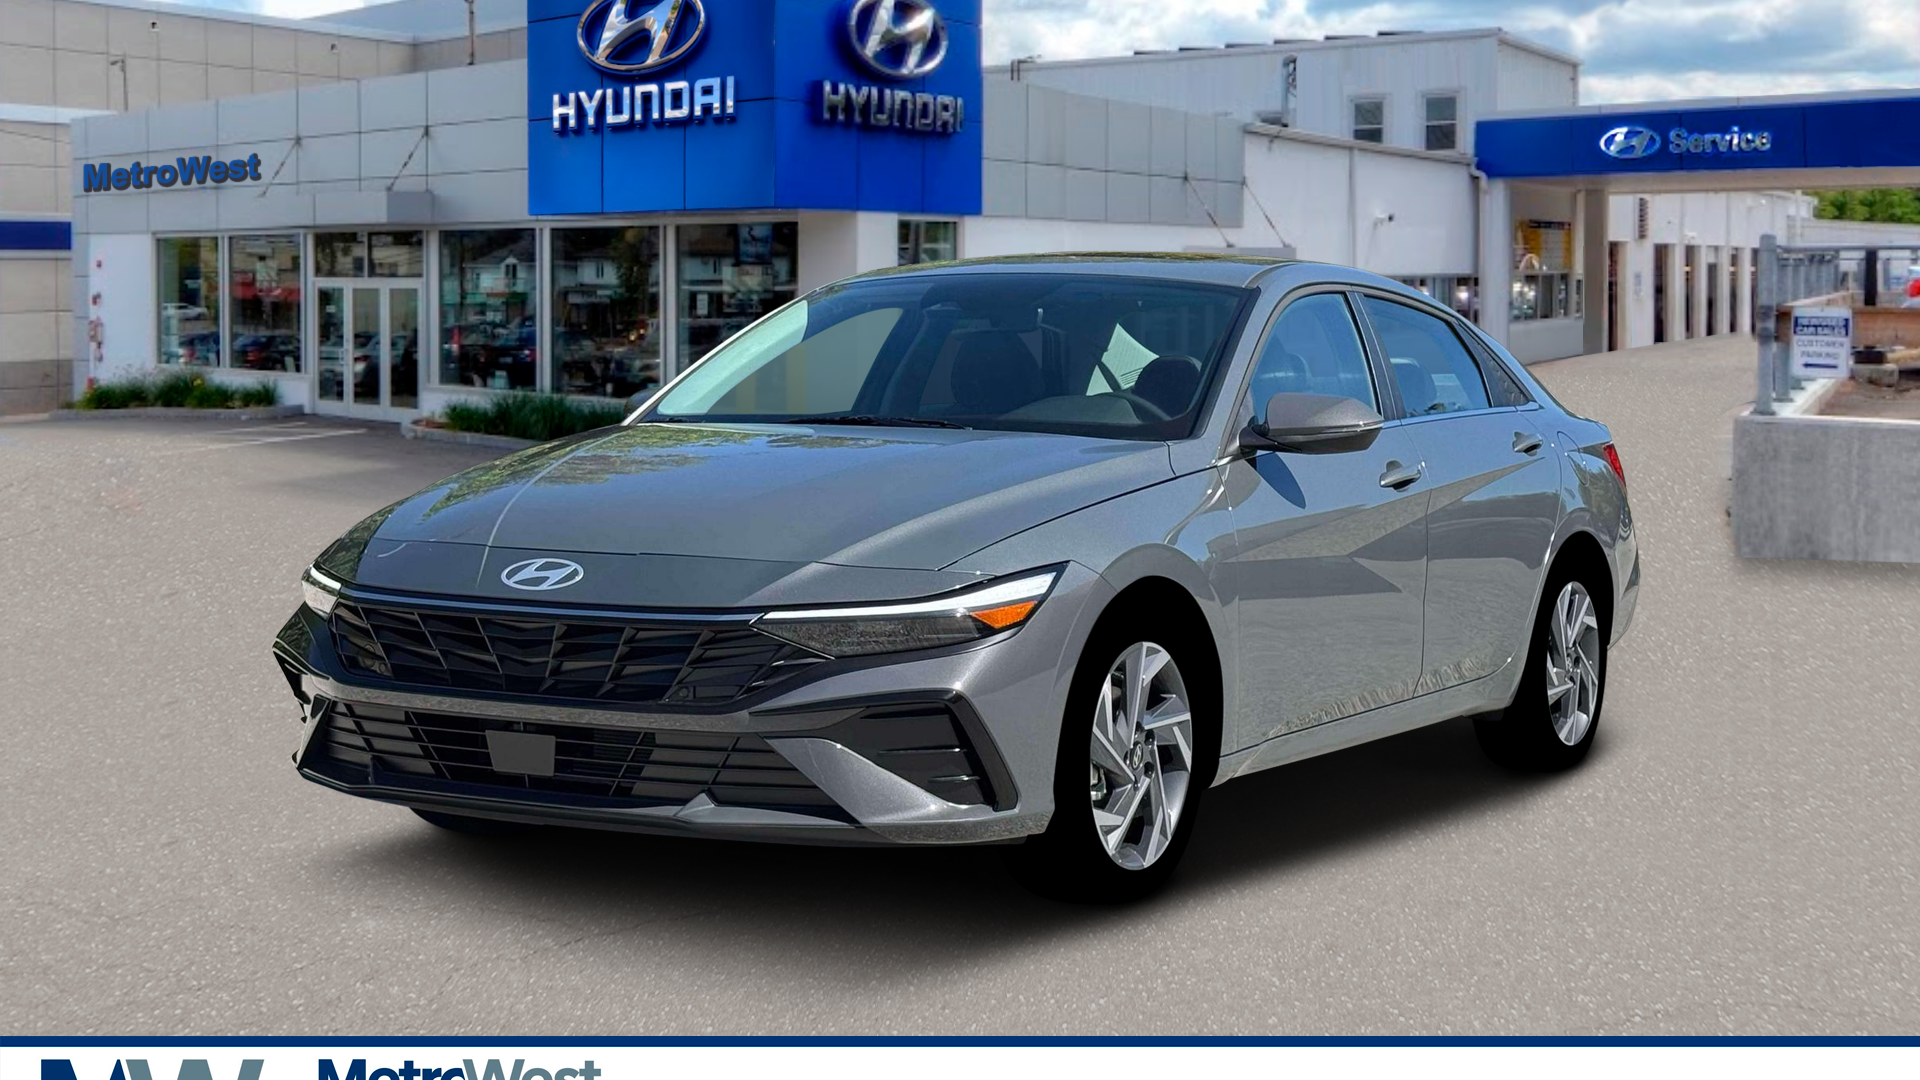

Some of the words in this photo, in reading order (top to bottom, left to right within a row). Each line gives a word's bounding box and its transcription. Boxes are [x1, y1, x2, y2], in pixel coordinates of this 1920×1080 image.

[552, 76, 736, 132] HYUNDAI
[822, 79, 963, 133] HYUNDAI
[1669, 126, 1772, 153] Service
[83, 153, 261, 193] MetroWest
[1796, 339, 1845, 349] CUSTOMER
[1800, 350, 1840, 360] PARKING
